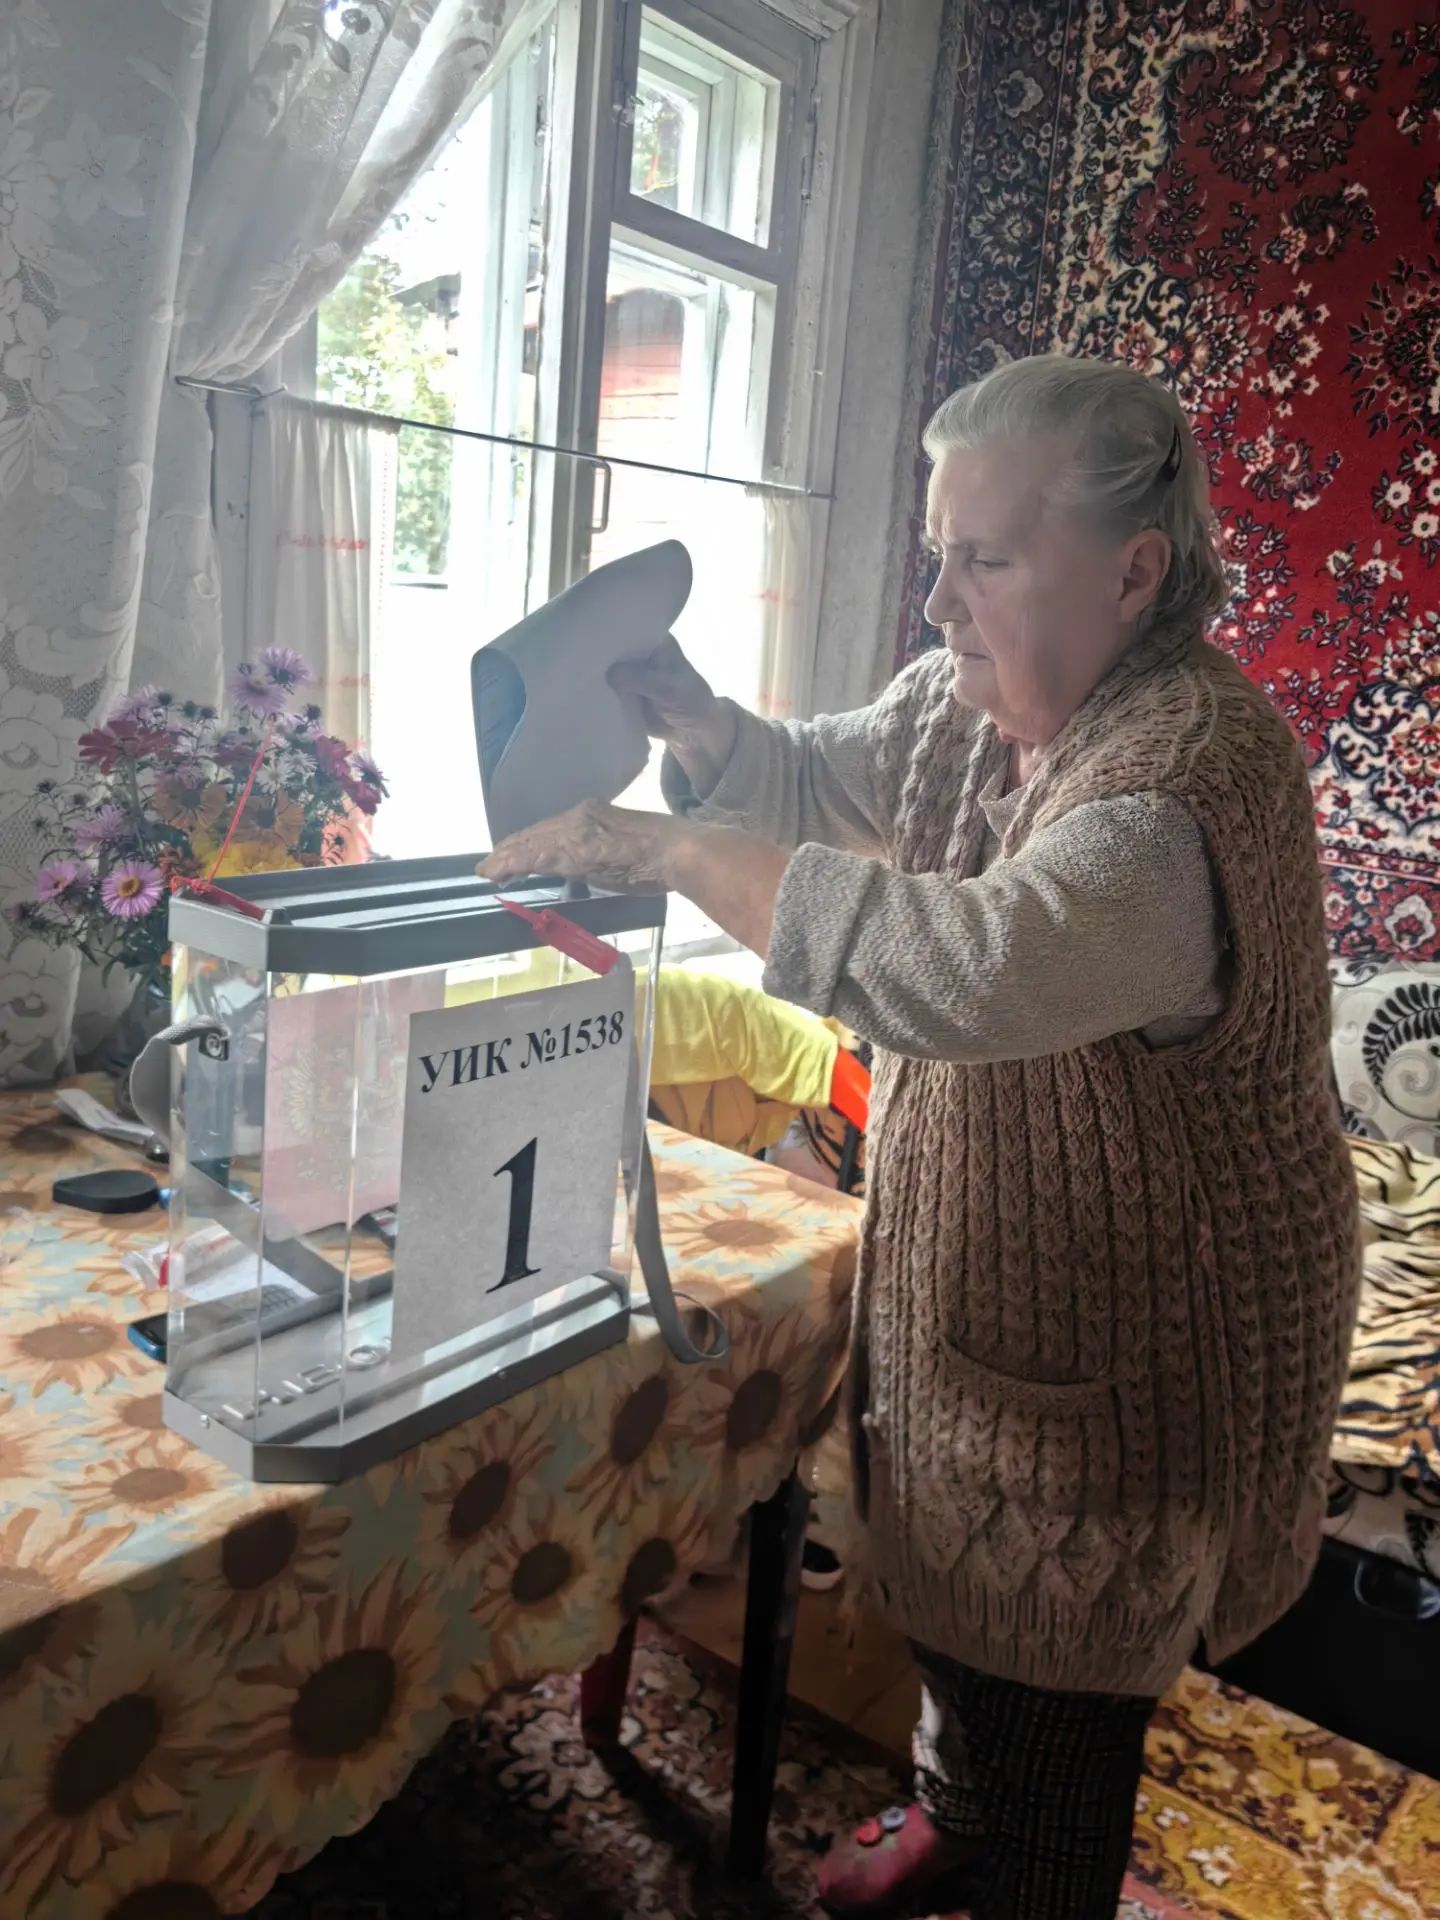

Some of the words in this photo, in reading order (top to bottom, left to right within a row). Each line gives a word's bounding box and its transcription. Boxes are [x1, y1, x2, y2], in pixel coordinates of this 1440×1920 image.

[418, 1037, 512, 1093] УИК
[520, 1010, 624, 1069] №1538
[486, 1137, 541, 1294] 1
